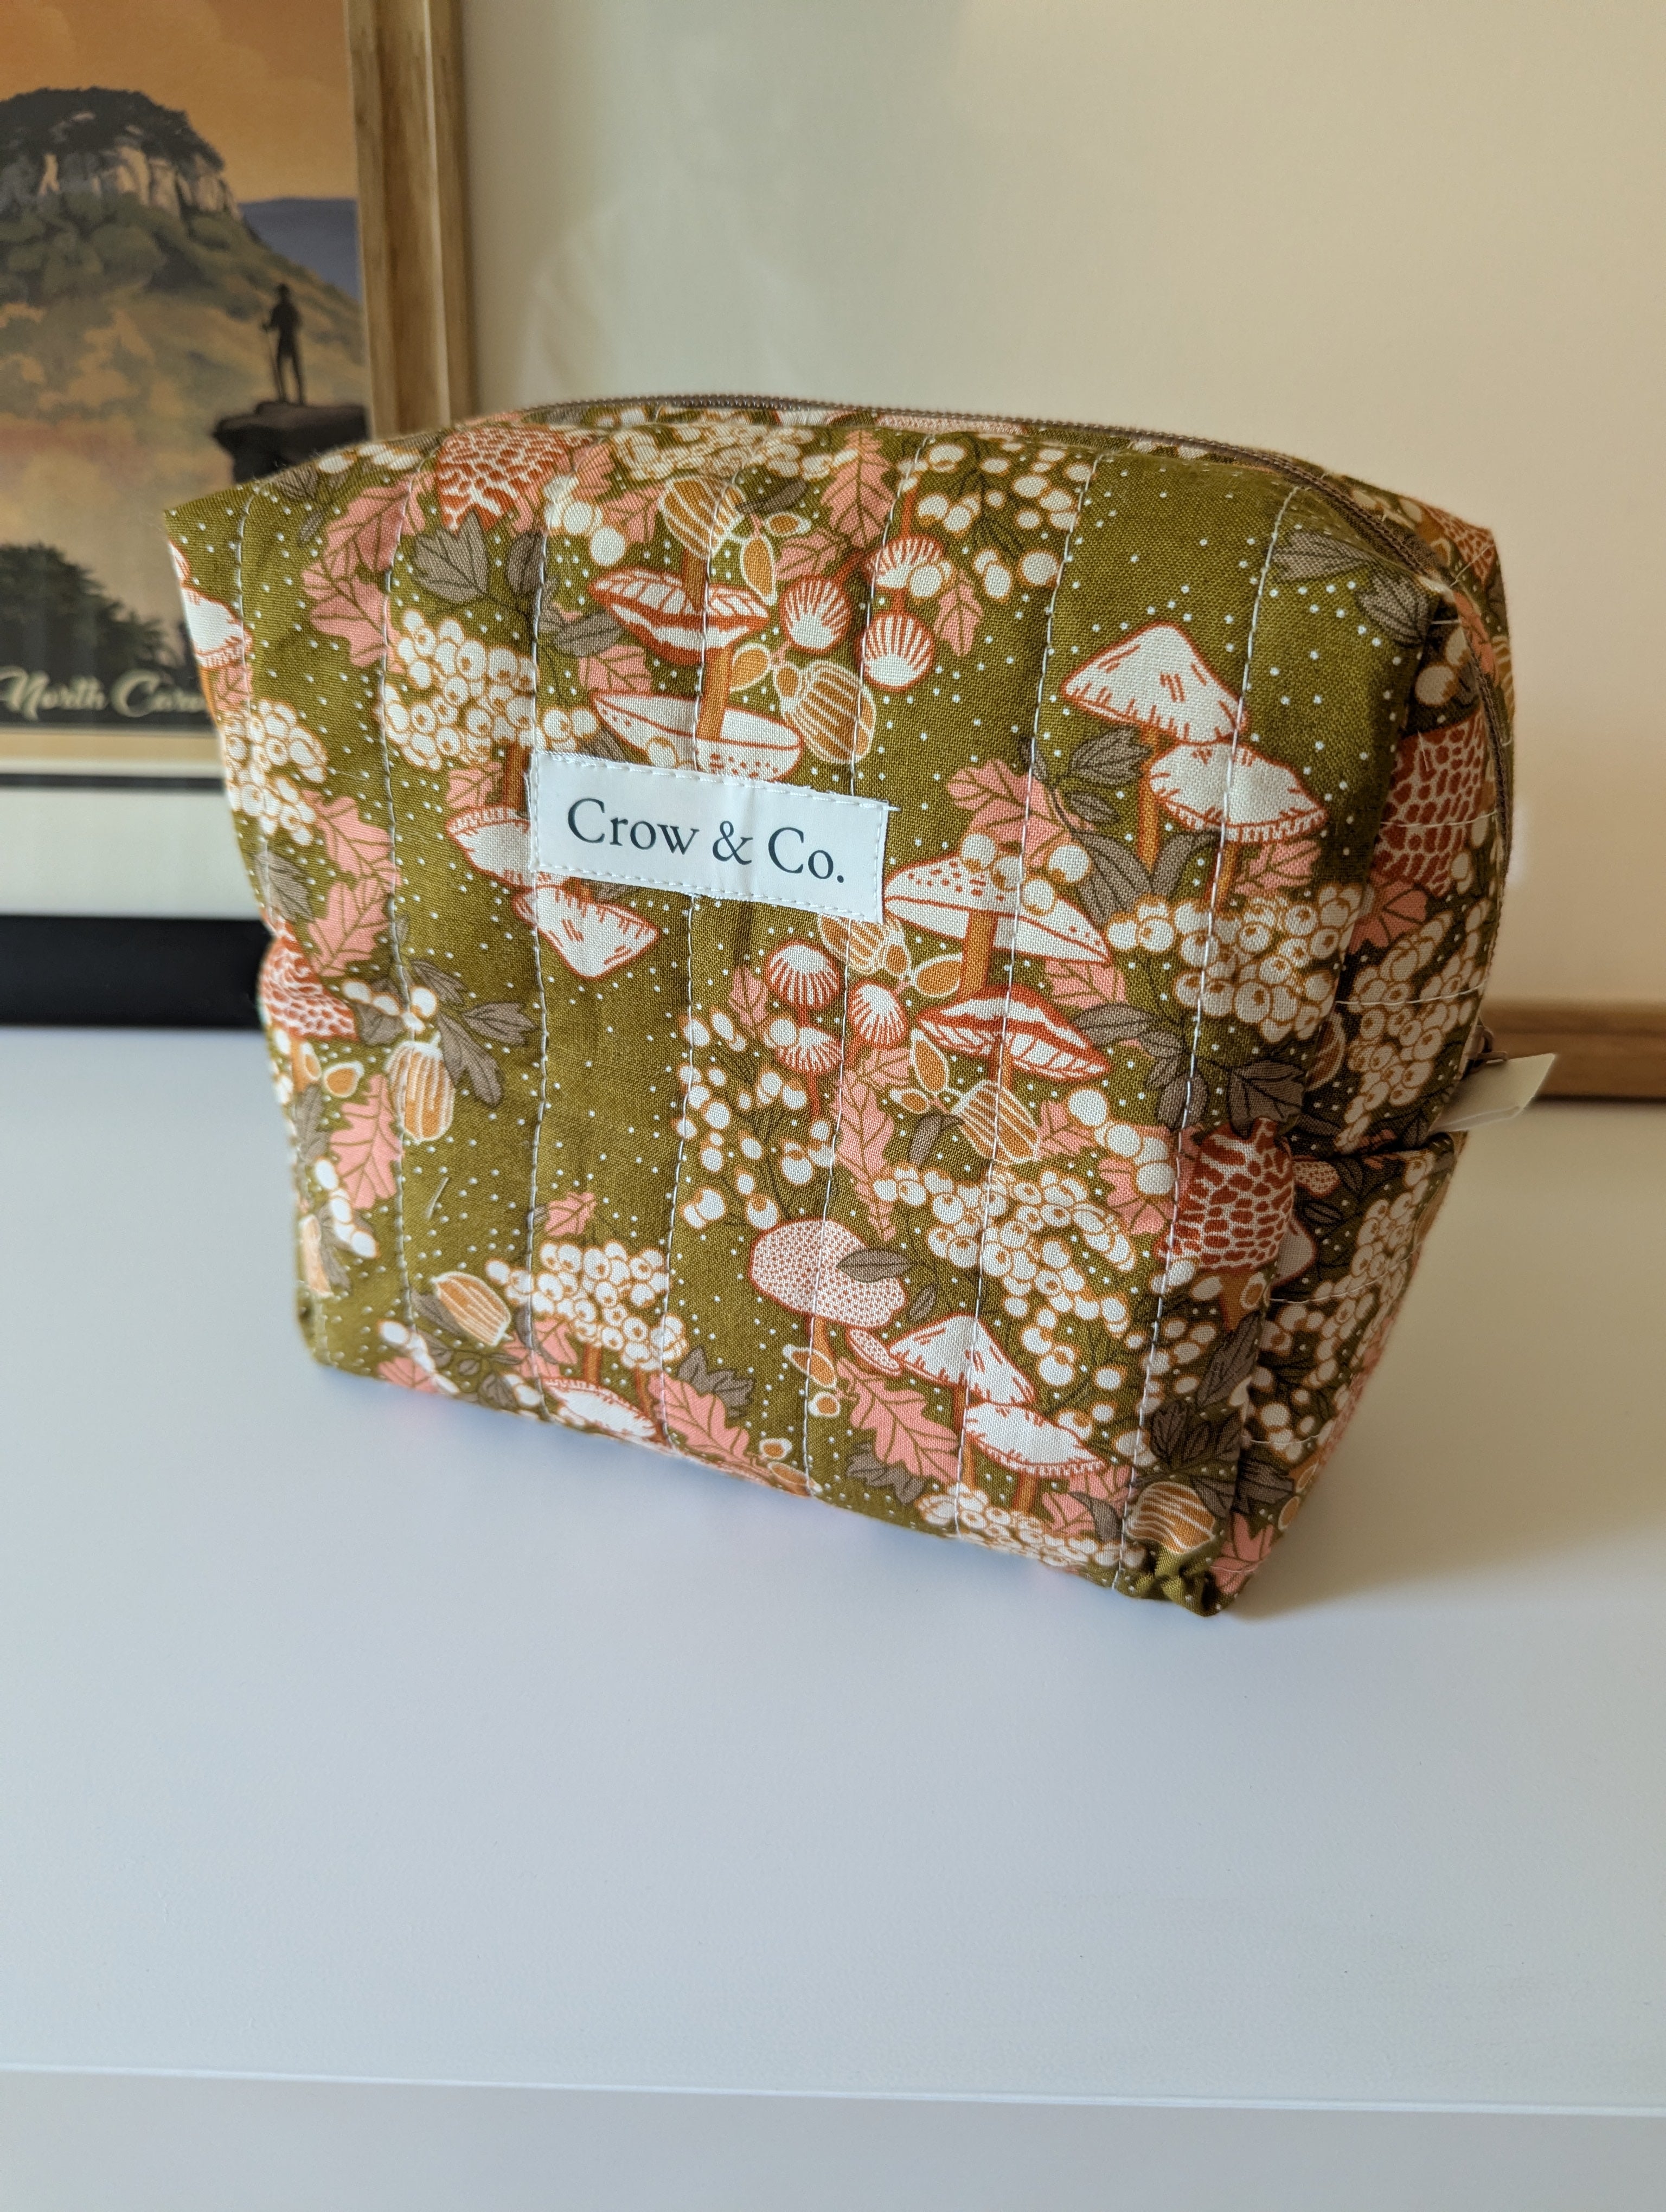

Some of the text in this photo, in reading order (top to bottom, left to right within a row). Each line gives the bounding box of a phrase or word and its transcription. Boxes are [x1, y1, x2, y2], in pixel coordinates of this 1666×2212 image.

[0, 665, 106, 721] North
[568, 798, 844, 883] Crow & Co.
